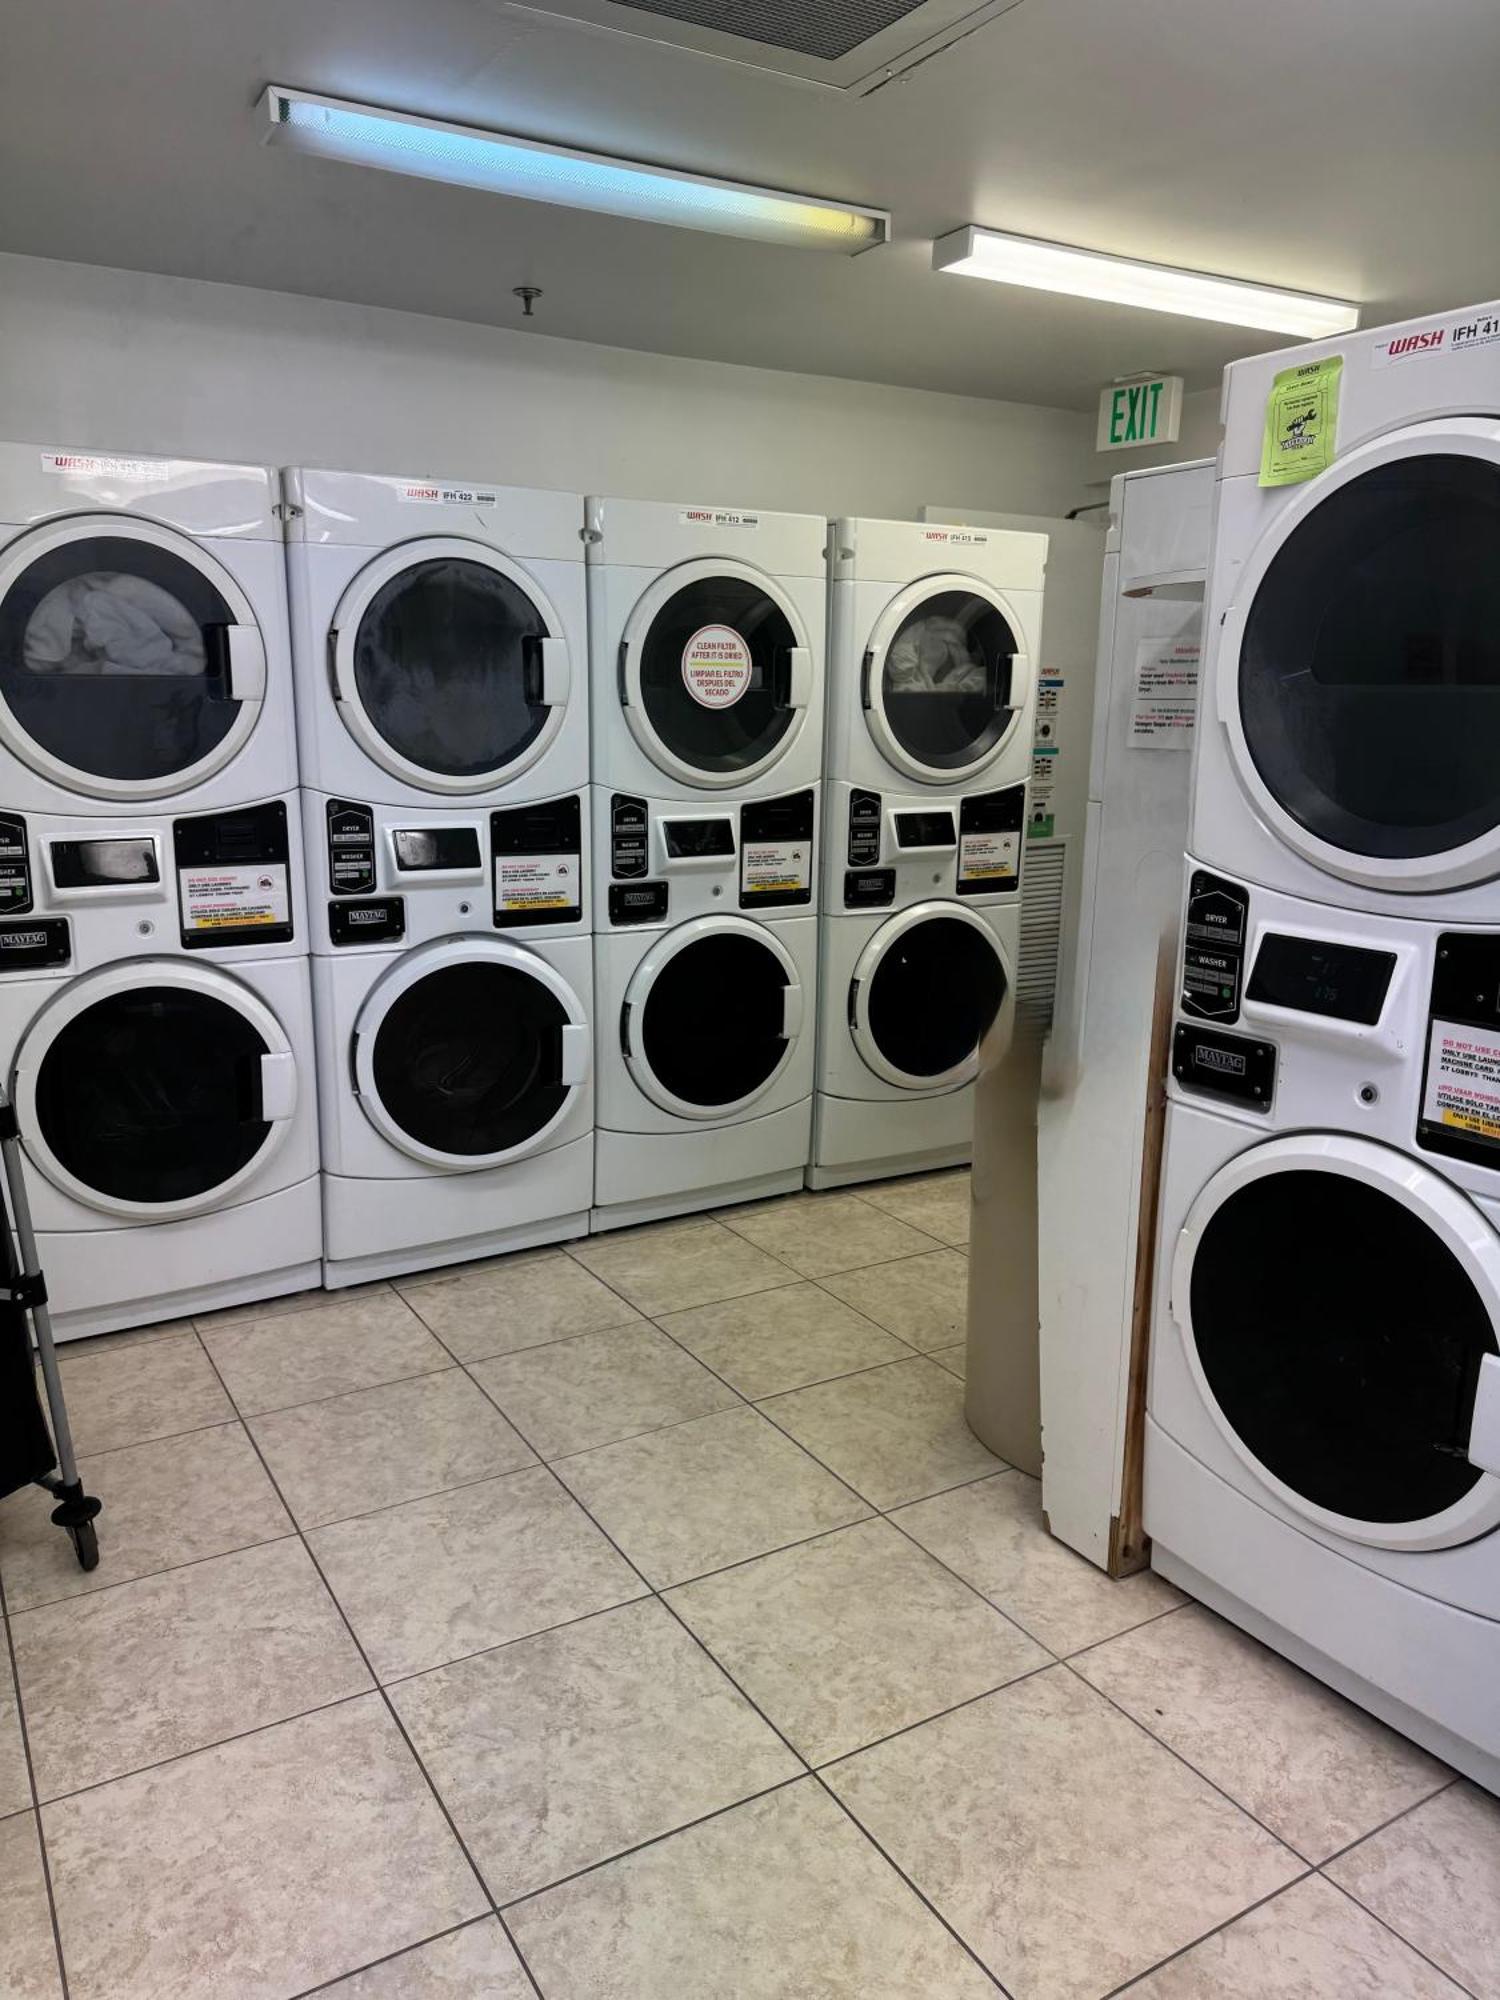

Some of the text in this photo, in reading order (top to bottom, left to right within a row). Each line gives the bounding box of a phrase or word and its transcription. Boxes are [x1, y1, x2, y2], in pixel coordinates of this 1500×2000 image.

[1388, 329, 1445, 356] WASH
[1453, 324, 1478, 342] IFH
[1110, 383, 1164, 443] EXIT
[407, 488, 439, 499] WASH
[687, 511, 713, 521] WASH
[696, 642, 737, 650] CLEAN FILTER
[692, 651, 710, 659] AFTER
[723, 652, 743, 660] DRIED
[690, 670, 744, 679] LIMPIAR EL FILTRO
[350, 911, 385, 921] MAYTAG
[1205, 913, 1228, 924] DRYER
[3, 935, 44, 945] MAYTAG
[1198, 955, 1227, 969] WASHER
[1443, 1039, 1454, 1047] DO
[1455, 1041, 1473, 1051] NOT
[1475, 1045, 1490, 1055] USE
[1198, 1048, 1242, 1069] MAYTAG
[1442, 1048, 1460, 1057] ONLY
[1462, 1051, 1477, 1060] USE
[1441, 1056, 1473, 1069] MACHINE
[1454, 1087, 1473, 1098] USAR
[1436, 1100, 1470, 1115] COMPRAR
[1471, 1108, 1481, 1116] EN
